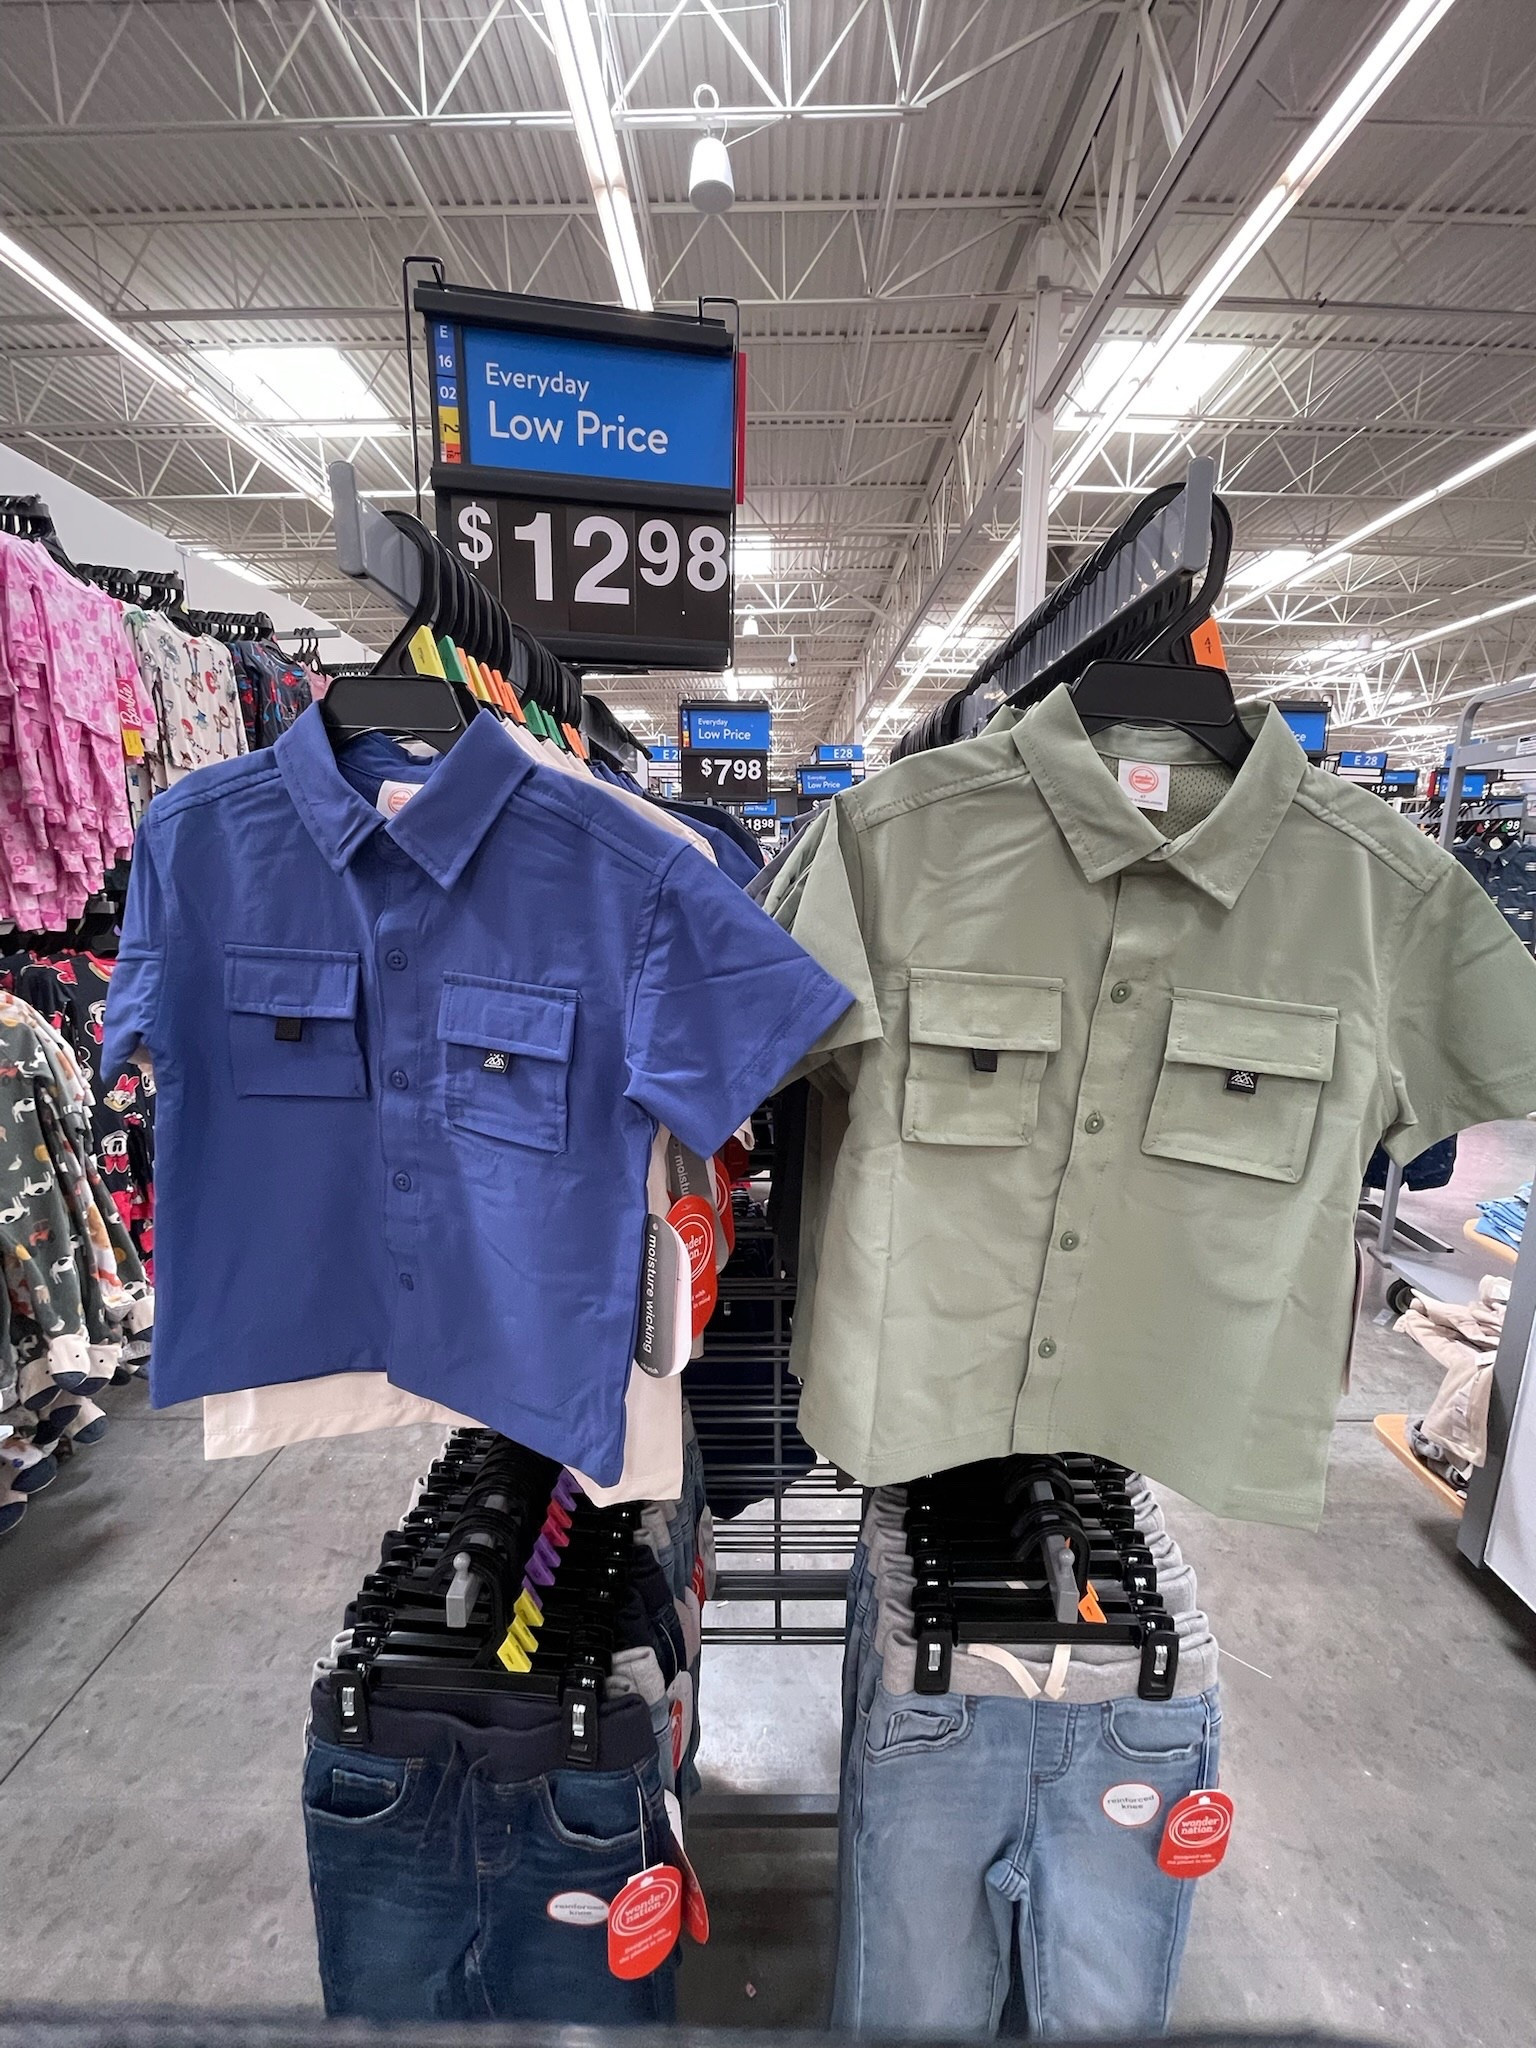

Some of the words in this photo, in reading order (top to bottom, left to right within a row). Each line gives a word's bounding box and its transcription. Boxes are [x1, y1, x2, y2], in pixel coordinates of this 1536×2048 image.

[439, 325, 449, 339] E
[438, 354, 453, 368] 16
[485, 362, 590, 402] Everyday
[440, 385, 457, 400] 02
[488, 400, 564, 445] Low
[577, 409, 669, 455] Price
[118, 681, 142, 727] Barbie
[697, 717, 728, 727] Everyday
[698, 727, 720, 740] Low
[723, 728, 751, 740] Price
[672, 749, 679, 760] 2
[807, 781, 821, 789] Low
[822, 780, 841, 789] Price
[674, 1155, 691, 1196] moistu
[645, 1234, 658, 1297] moisture
[642, 1301, 656, 1354] wicking
[1181, 1815, 1220, 1827] wonder
[1181, 1826, 1214, 1835] nation
[625, 1890, 667, 1917] wonder
[626, 1901, 661, 1925] nation
